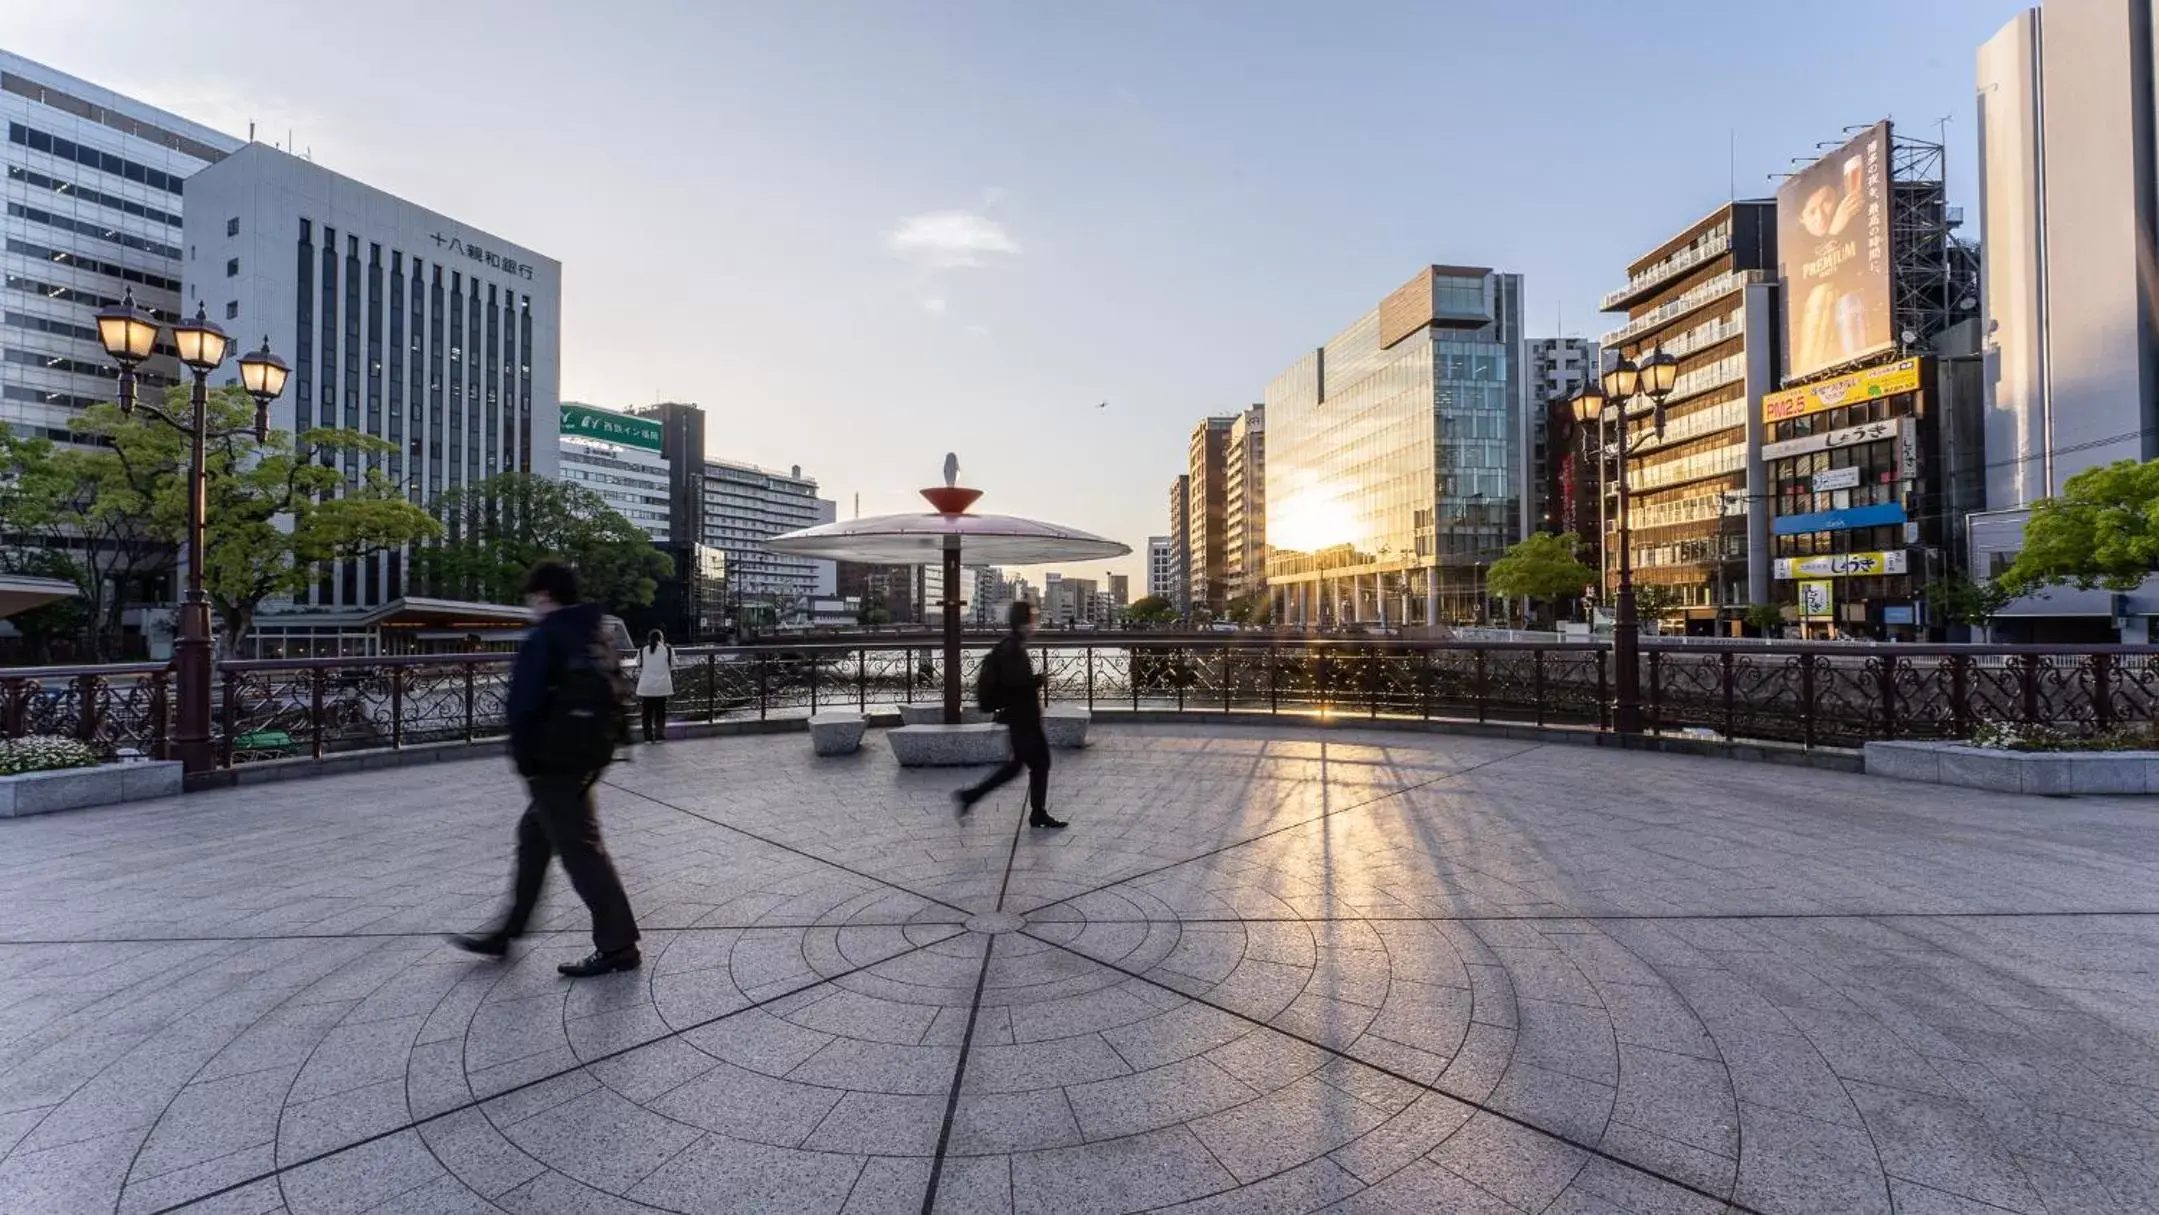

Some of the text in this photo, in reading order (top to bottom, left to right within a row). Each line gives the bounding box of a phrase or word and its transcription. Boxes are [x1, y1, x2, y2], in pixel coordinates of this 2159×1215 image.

[430, 232, 534, 280] 十八親和銀行
[1802, 241, 1856, 280] PREMIUM
[1767, 396, 1805, 420] PM2.5
